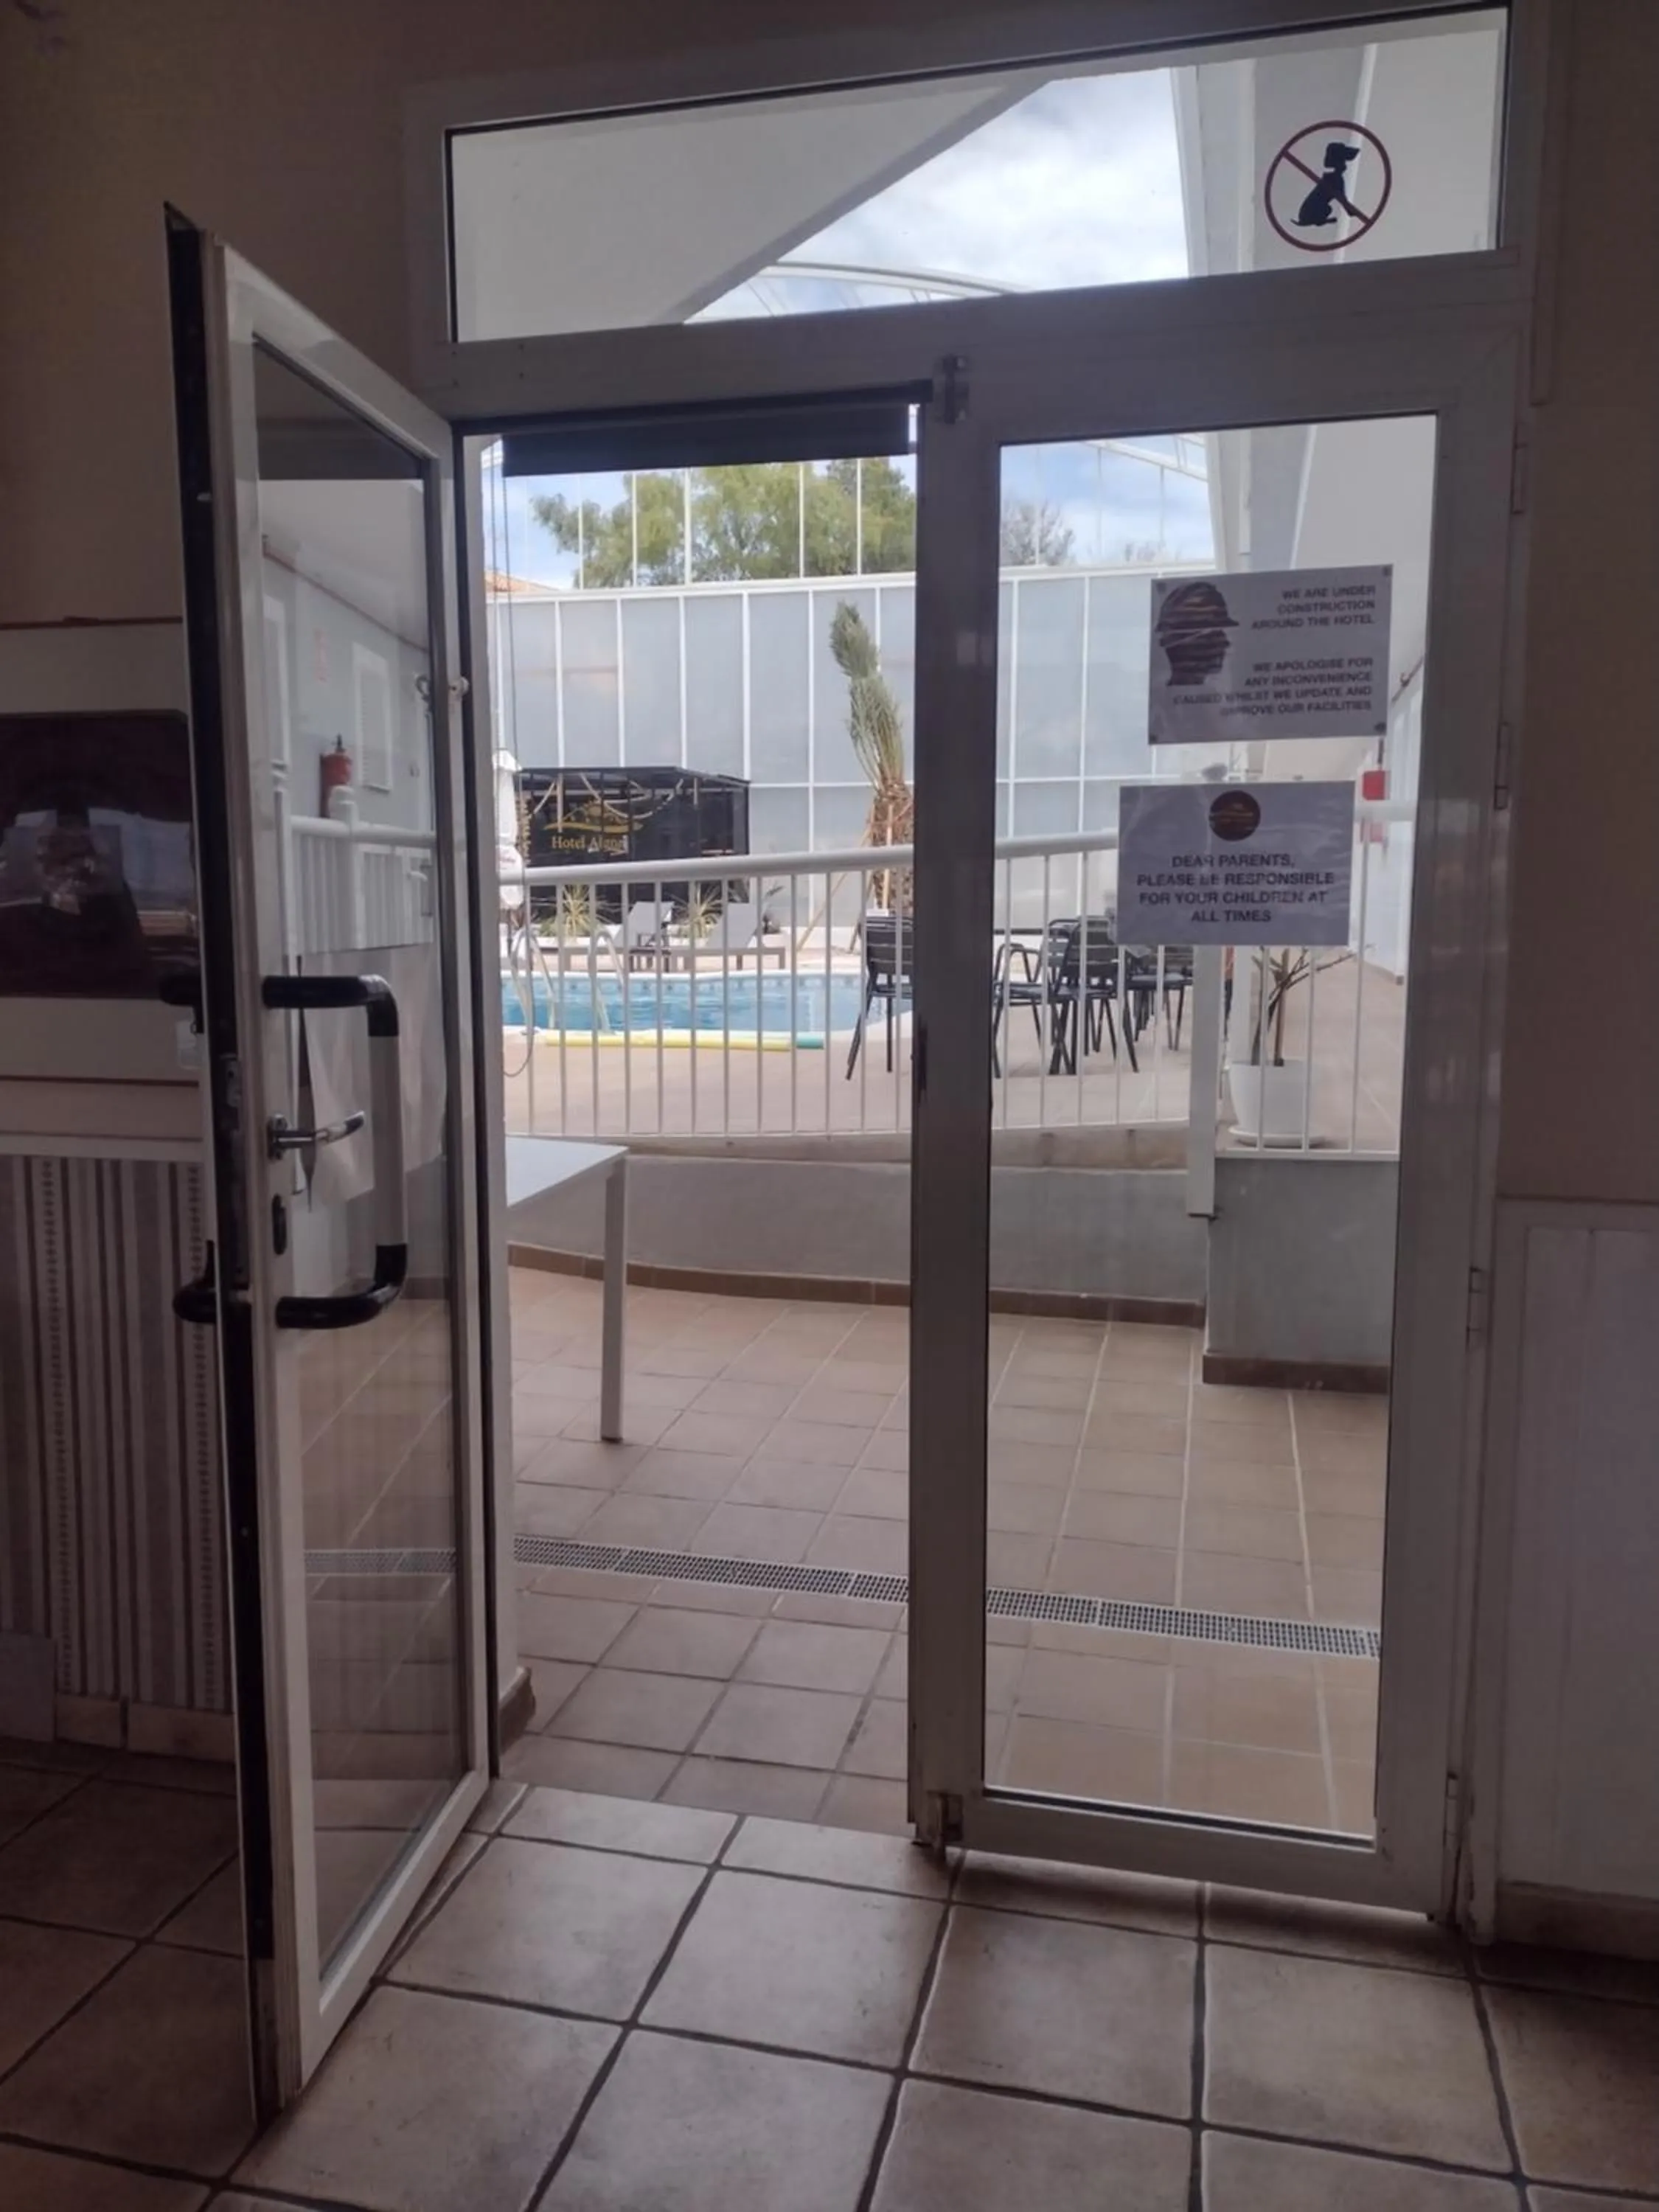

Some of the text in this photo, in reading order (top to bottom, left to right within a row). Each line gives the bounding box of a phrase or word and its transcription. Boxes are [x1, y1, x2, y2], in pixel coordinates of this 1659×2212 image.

[1281, 585, 1376, 599] WE ARE UNDER
[1277, 600, 1375, 615] CONSTRUCTION
[1251, 618, 1304, 629] AROUND
[1308, 616, 1329, 626] THE
[1253, 662, 1273, 672] WE
[1348, 658, 1373, 667] FOR
[1245, 672, 1371, 686] ANY INCONVENIENCE
[1273, 689, 1291, 700] WE
[1296, 686, 1340, 698] UPDATE
[1346, 686, 1372, 696] AND
[1278, 702, 1304, 714] OUR
[552, 834, 585, 849] Hotel
[1172, 854, 1295, 868] DEAR PARENTS,
[1137, 874, 1195, 886] PLEASE
[1225, 872, 1334, 885] RESPONSIBLE
[1139, 890, 1329, 905] FOR YOUR CHILDREN AT
[1192, 910, 1272, 922] ALL TIMES
